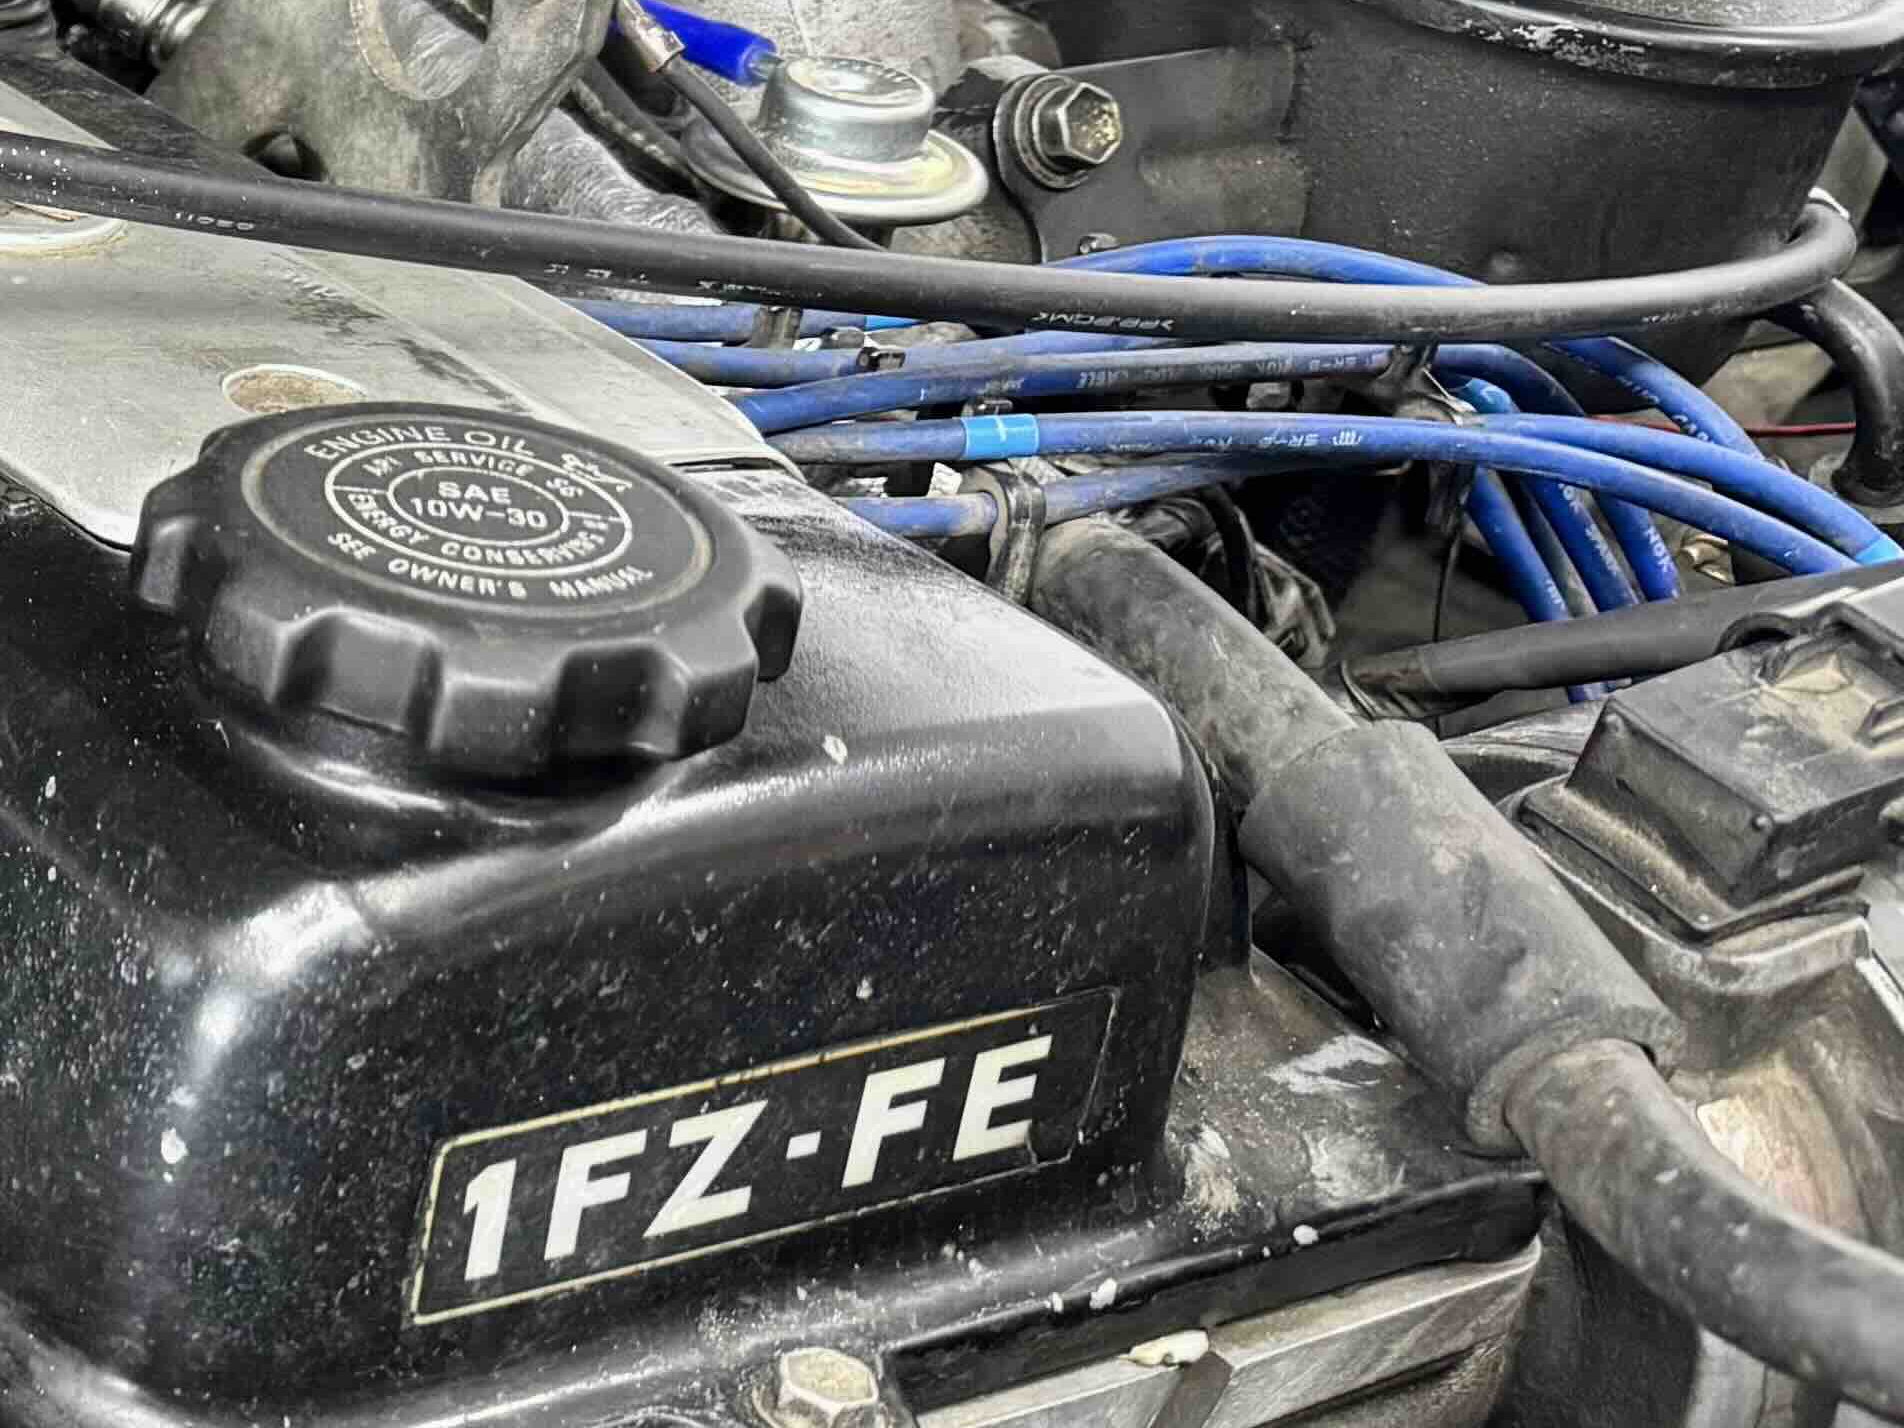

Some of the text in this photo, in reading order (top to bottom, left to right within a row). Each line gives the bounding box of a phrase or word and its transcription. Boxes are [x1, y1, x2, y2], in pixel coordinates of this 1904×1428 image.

[304, 426, 537, 462] ENGINE OIL
[413, 450, 535, 477] SERVICE
[437, 481, 513, 505] SAE
[347, 492, 430, 545] ENERGY
[409, 496, 549, 529] 10W-30
[327, 531, 655, 600] SEE OWNER'S MANUAL
[462, 1033, 1054, 1283] 1FZ-FE
